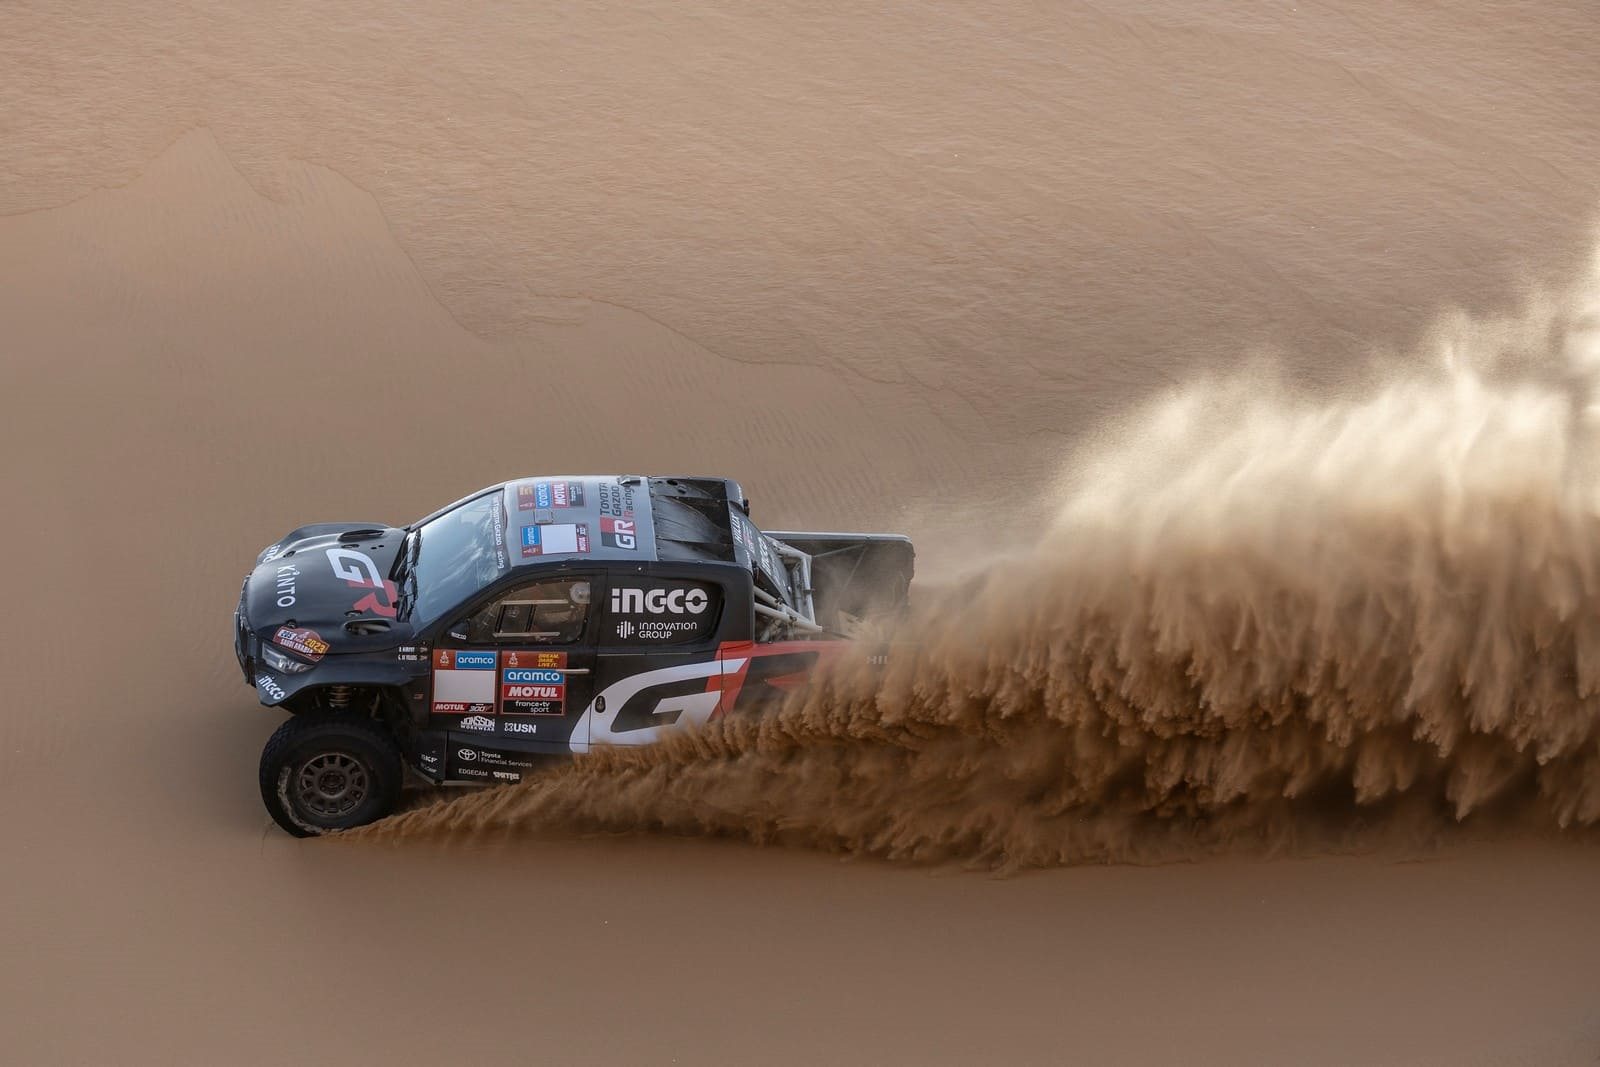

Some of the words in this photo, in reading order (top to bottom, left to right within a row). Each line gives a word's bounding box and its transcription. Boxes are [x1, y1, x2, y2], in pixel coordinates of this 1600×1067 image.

[554, 483, 566, 505] MOTUL
[599, 482, 610, 515] TOYOTA
[612, 486, 622, 517] GAZOO
[614, 519, 636, 550] GR
[326, 548, 398, 617] GR
[639, 622, 697, 631] INNOVATION
[638, 630, 672, 639] GROUP
[304, 638, 327, 654] 2023
[458, 656, 494, 664] aramco
[508, 671, 560, 681] aramco
[508, 686, 558, 697] MOTUL
[435, 703, 465, 711] MOTUL
[460, 715, 496, 727] JONSSON
[514, 723, 537, 733] USN
[481, 751, 501, 759] Toyota
[481, 757, 508, 766] Financial
[508, 759, 533, 768] Services
[458, 768, 488, 776] EDGECAM
